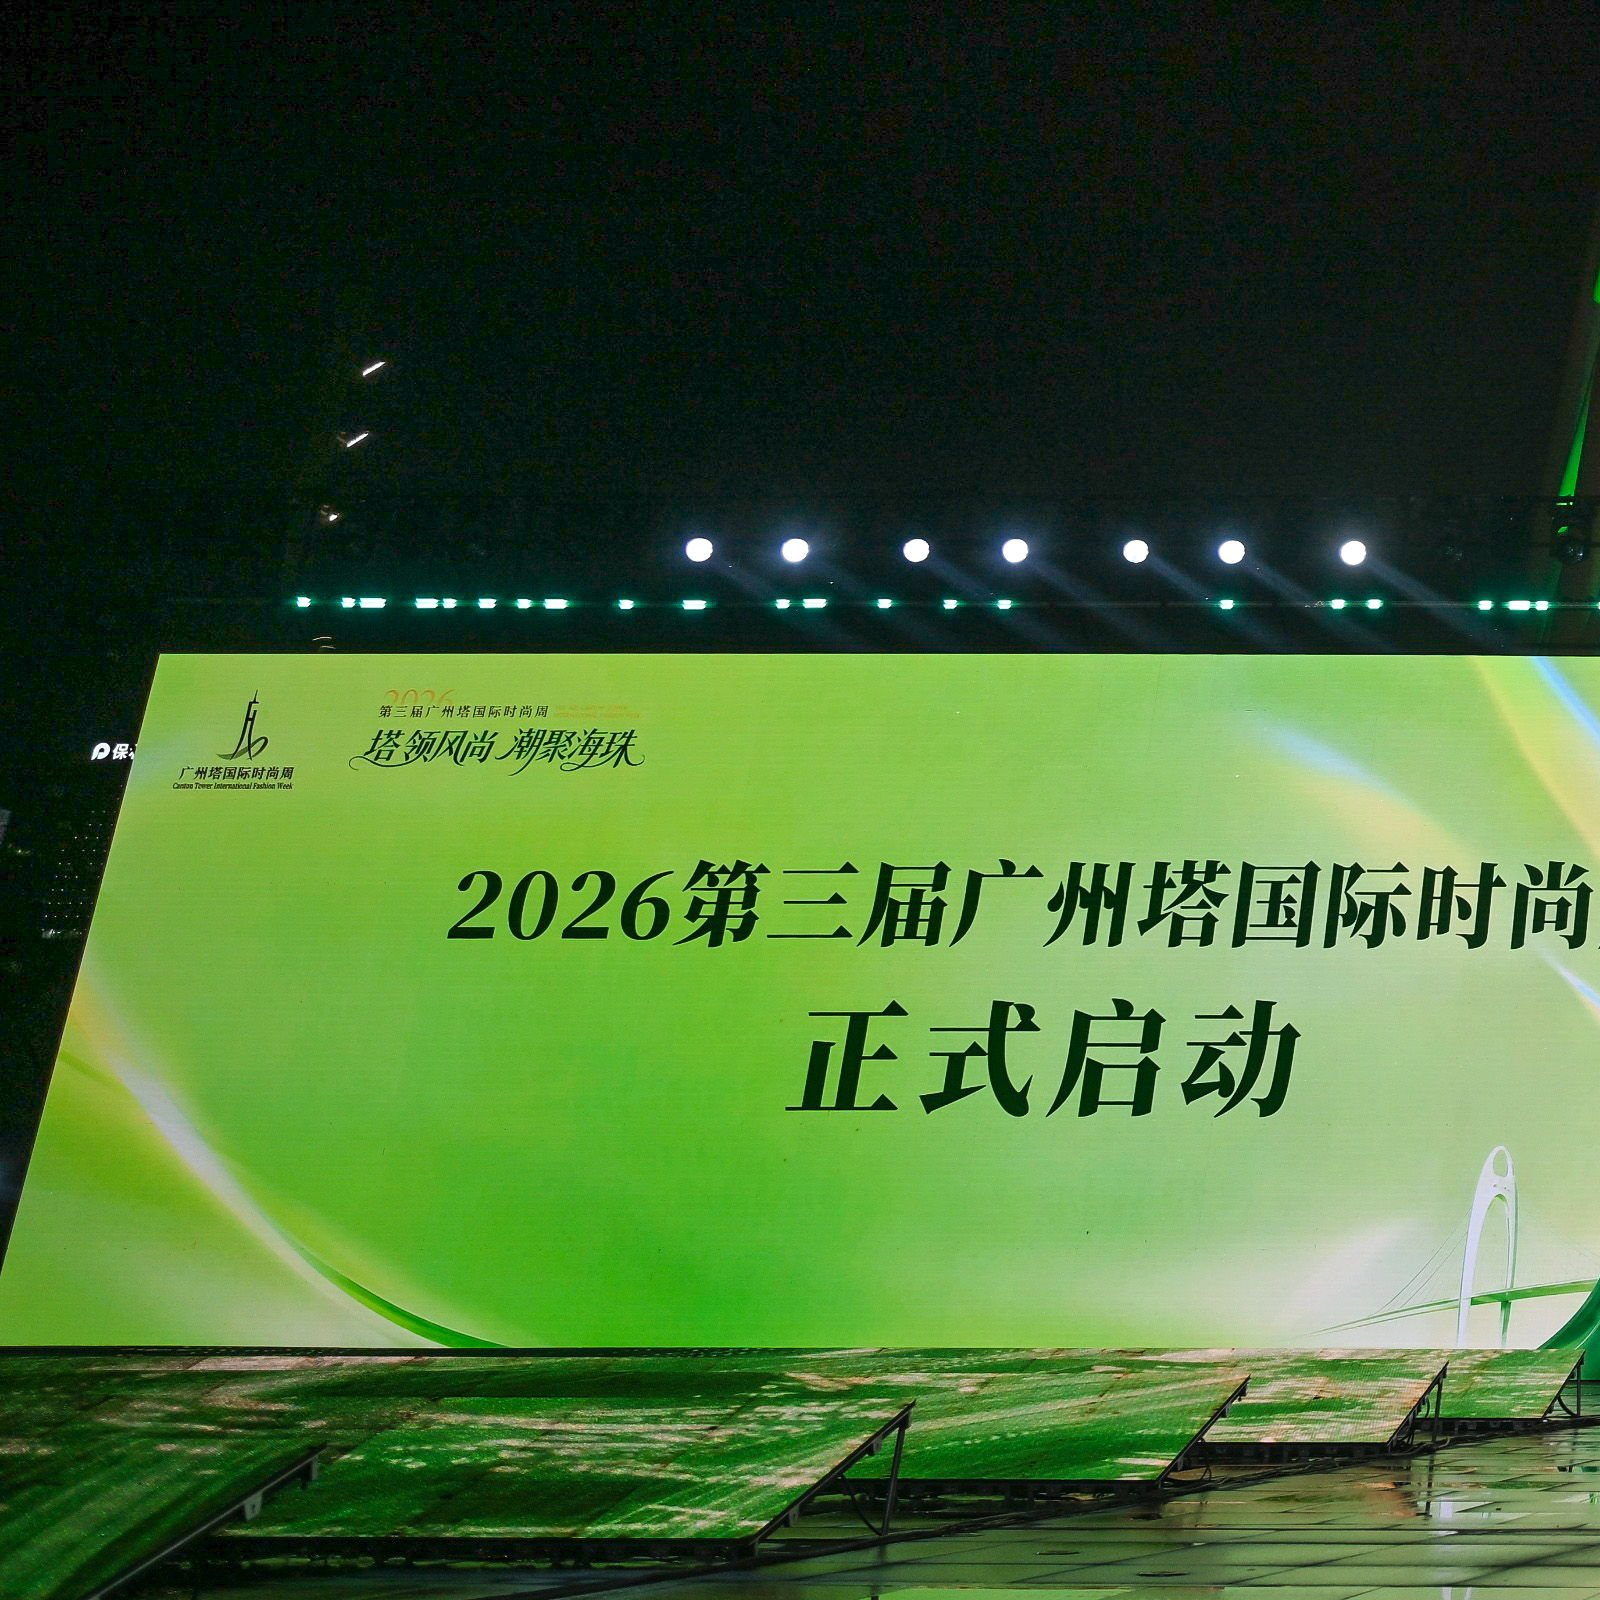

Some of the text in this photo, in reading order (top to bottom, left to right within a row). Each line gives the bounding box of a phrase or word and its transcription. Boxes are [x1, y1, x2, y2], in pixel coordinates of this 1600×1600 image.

[379, 705, 549, 718] 第三届广州塔国际时尚周
[349, 727, 645, 777] 塔领风尚 潮聚海珠
[179, 766, 295, 780] 广州塔国际时尚周
[784, 998, 1302, 1119] 正式启动
